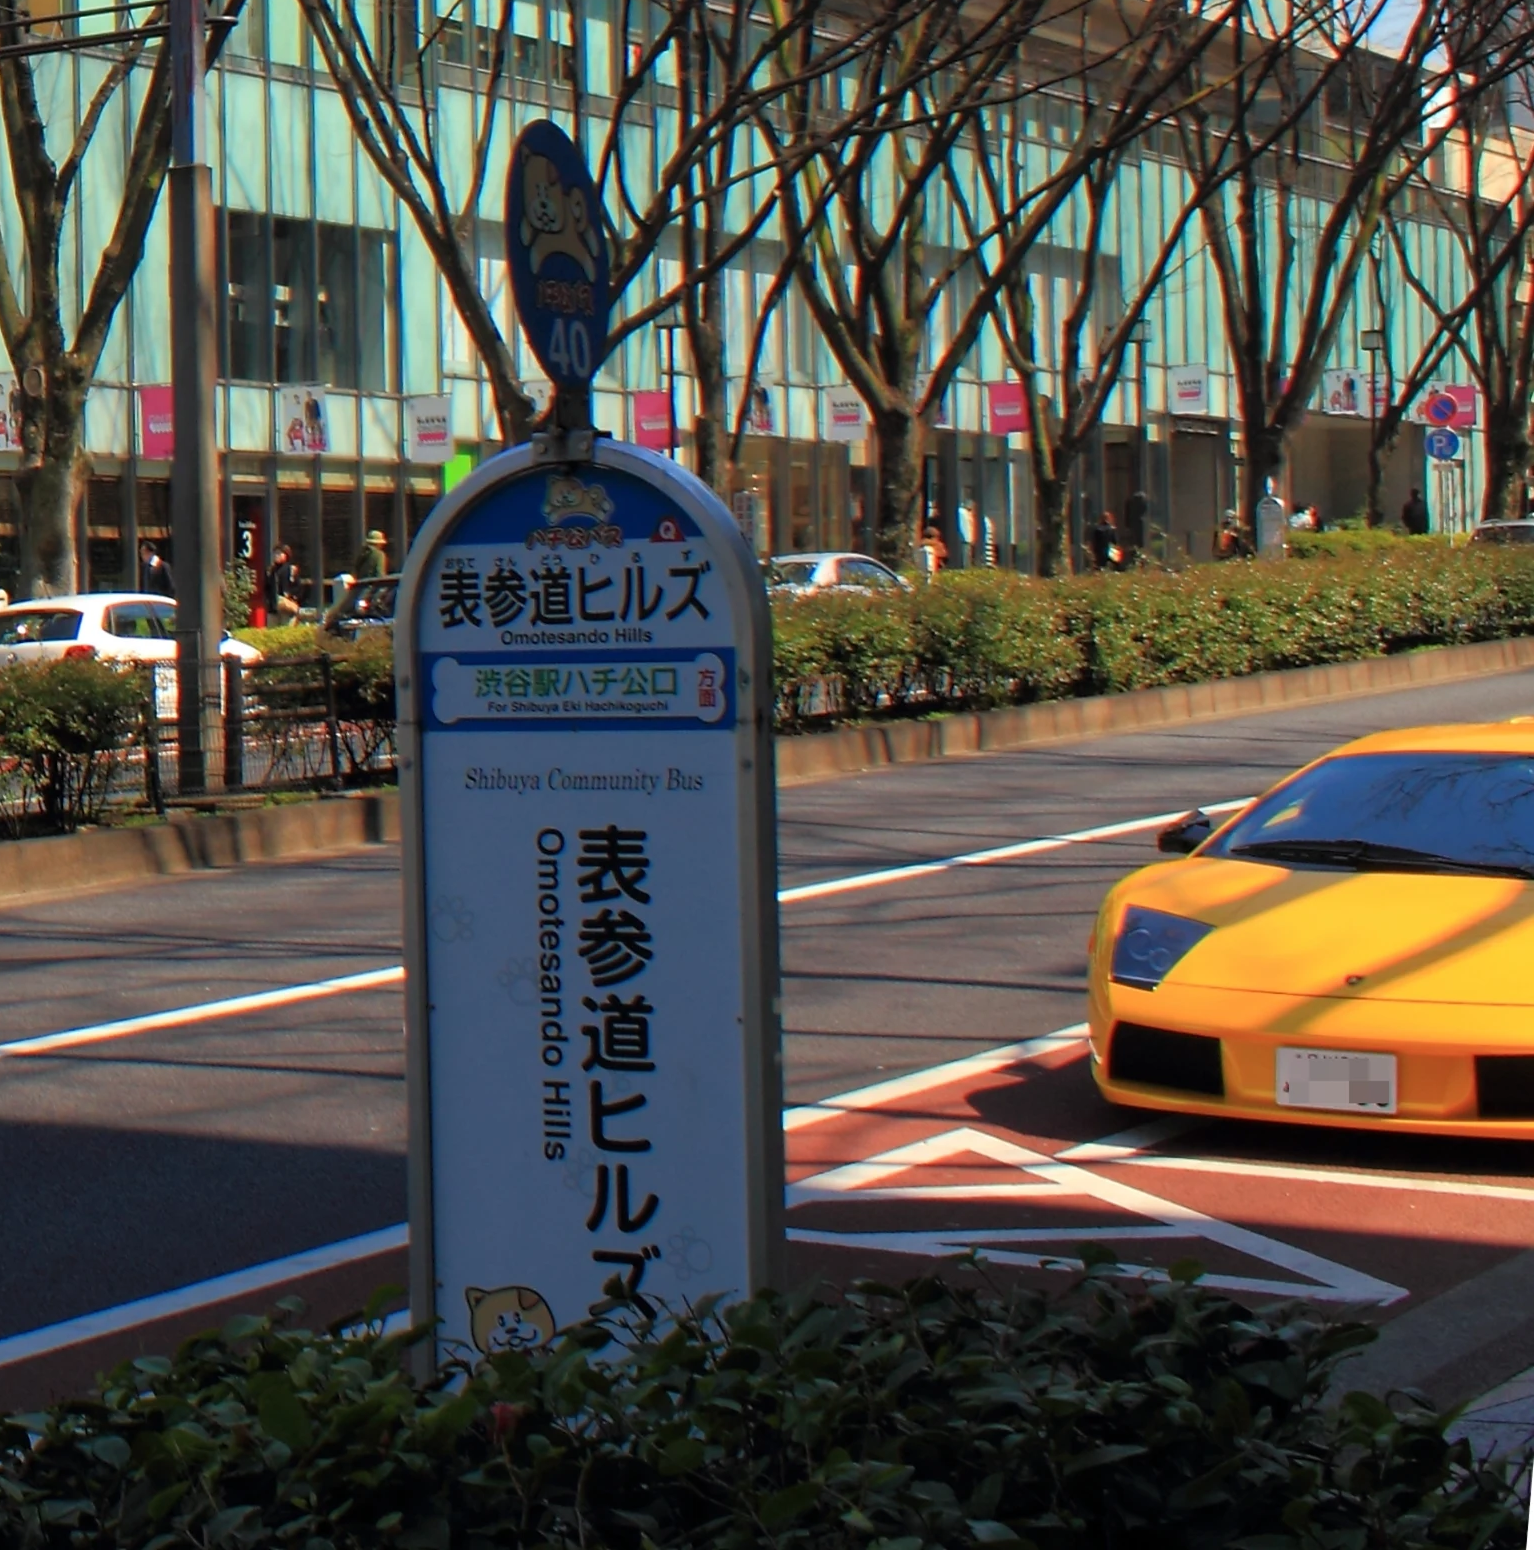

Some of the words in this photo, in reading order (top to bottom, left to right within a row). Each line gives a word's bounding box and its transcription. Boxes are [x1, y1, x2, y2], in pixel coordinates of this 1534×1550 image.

[549, 318, 592, 378] 40
[242, 530, 253, 559] 3
[525, 524, 625, 550] ハチ公バス
[439, 560, 712, 629] 表参道ヒルズ
[500, 629, 610, 646] Omotesando
[615, 627, 653, 643] Hills
[475, 666, 677, 698] 渋谷駅ハチ公口
[697, 668, 717, 708] 方面
[487, 700, 508, 713] For
[510, 700, 560, 715] Shibuya
[563, 700, 581, 712] Eki
[585, 699, 669, 714] Hachikoguchi
[464, 767, 540, 795] Shibuya
[547, 766, 660, 796] Community
[665, 767, 704, 791] Bus
[536, 827, 570, 1067] Omotesando
[577, 824, 662, 1320] 表参道ヒルズ
[543, 1079, 571, 1161] Hills
